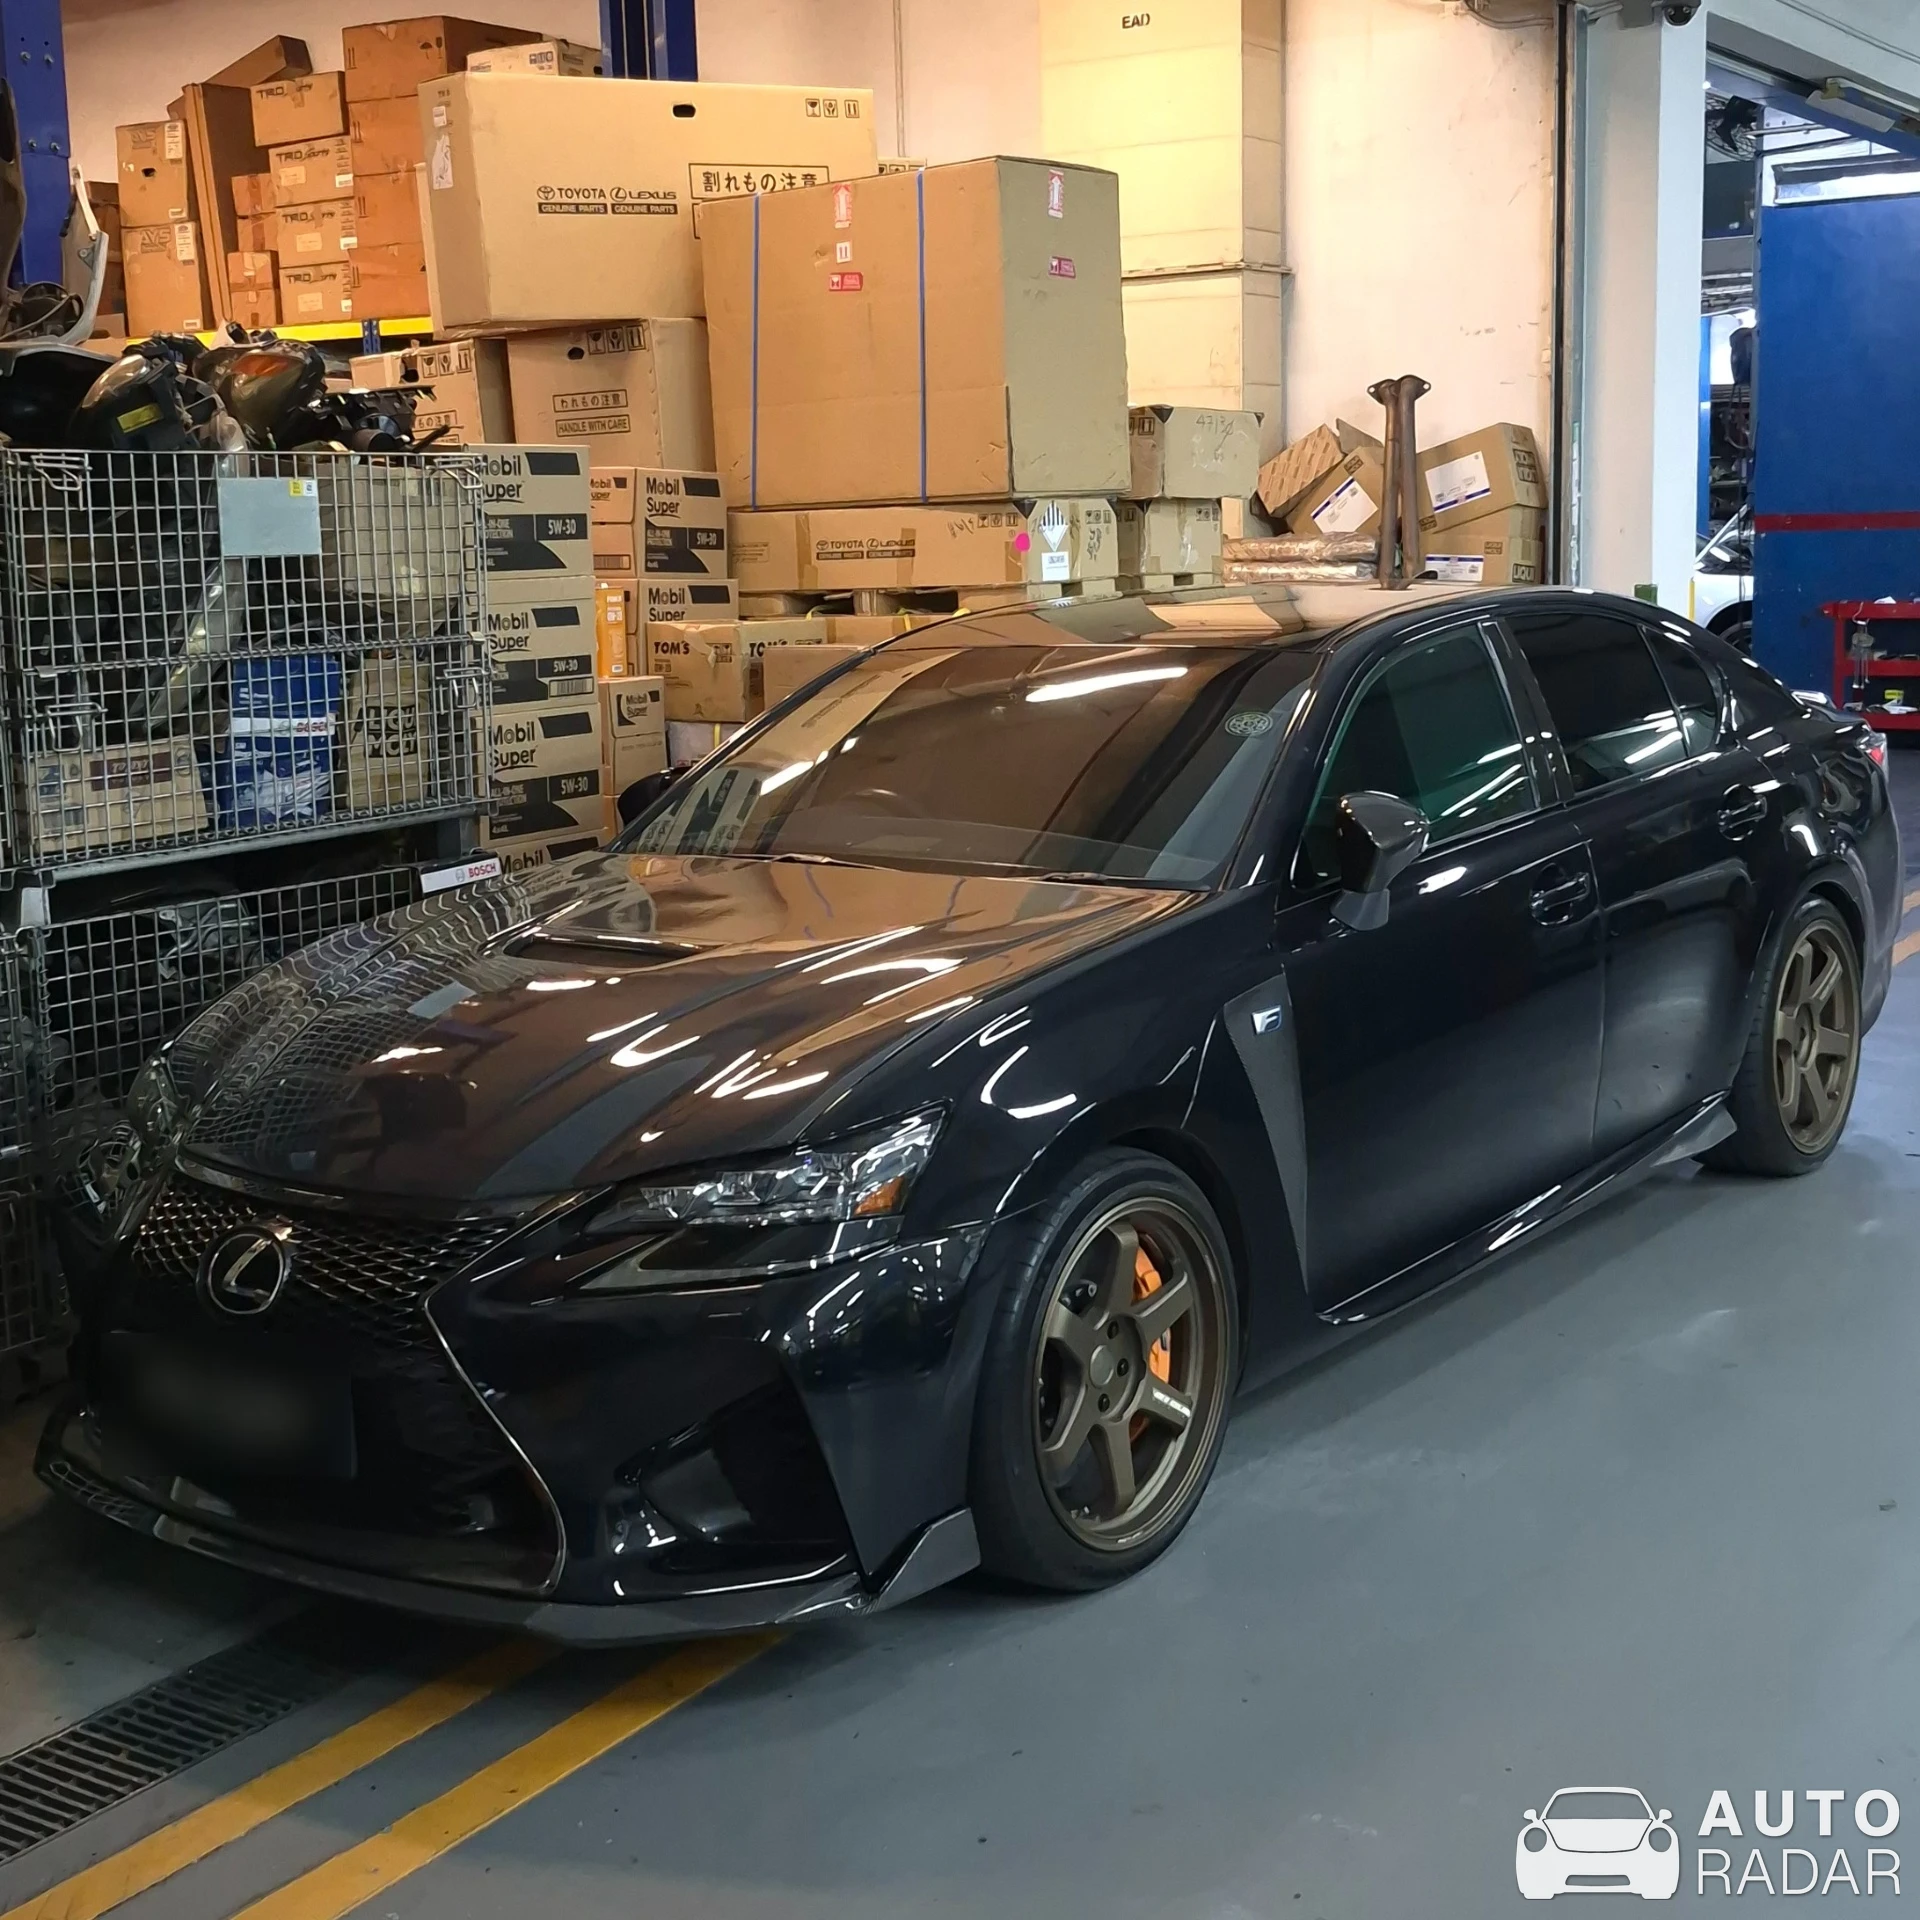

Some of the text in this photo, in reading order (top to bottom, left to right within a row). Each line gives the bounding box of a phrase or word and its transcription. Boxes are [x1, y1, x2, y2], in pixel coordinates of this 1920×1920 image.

[557, 187, 677, 200] TOYOTA LEXUS
[541, 203, 605, 213] GENUINE PARTS
[613, 204, 675, 213] GENUINE PARTS
[558, 418, 627, 433] HANDLE WITH CARE
[646, 477, 680, 496] Mobil
[590, 492, 611, 501] uper
[646, 497, 681, 515] Super
[548, 518, 577, 536] 5W-30
[830, 540, 864, 549] TOYOTA
[648, 588, 686, 605] Mobil
[488, 612, 529, 631] Mobil
[649, 607, 686, 622] Super
[489, 633, 530, 651] Super
[654, 640, 690, 655] TOM'S
[553, 658, 579, 673] 5W-30
[488, 721, 535, 746] Mobil
[490, 748, 537, 769] Super
[561, 776, 589, 795] 5W-30
[468, 862, 497, 878] BOSCH
